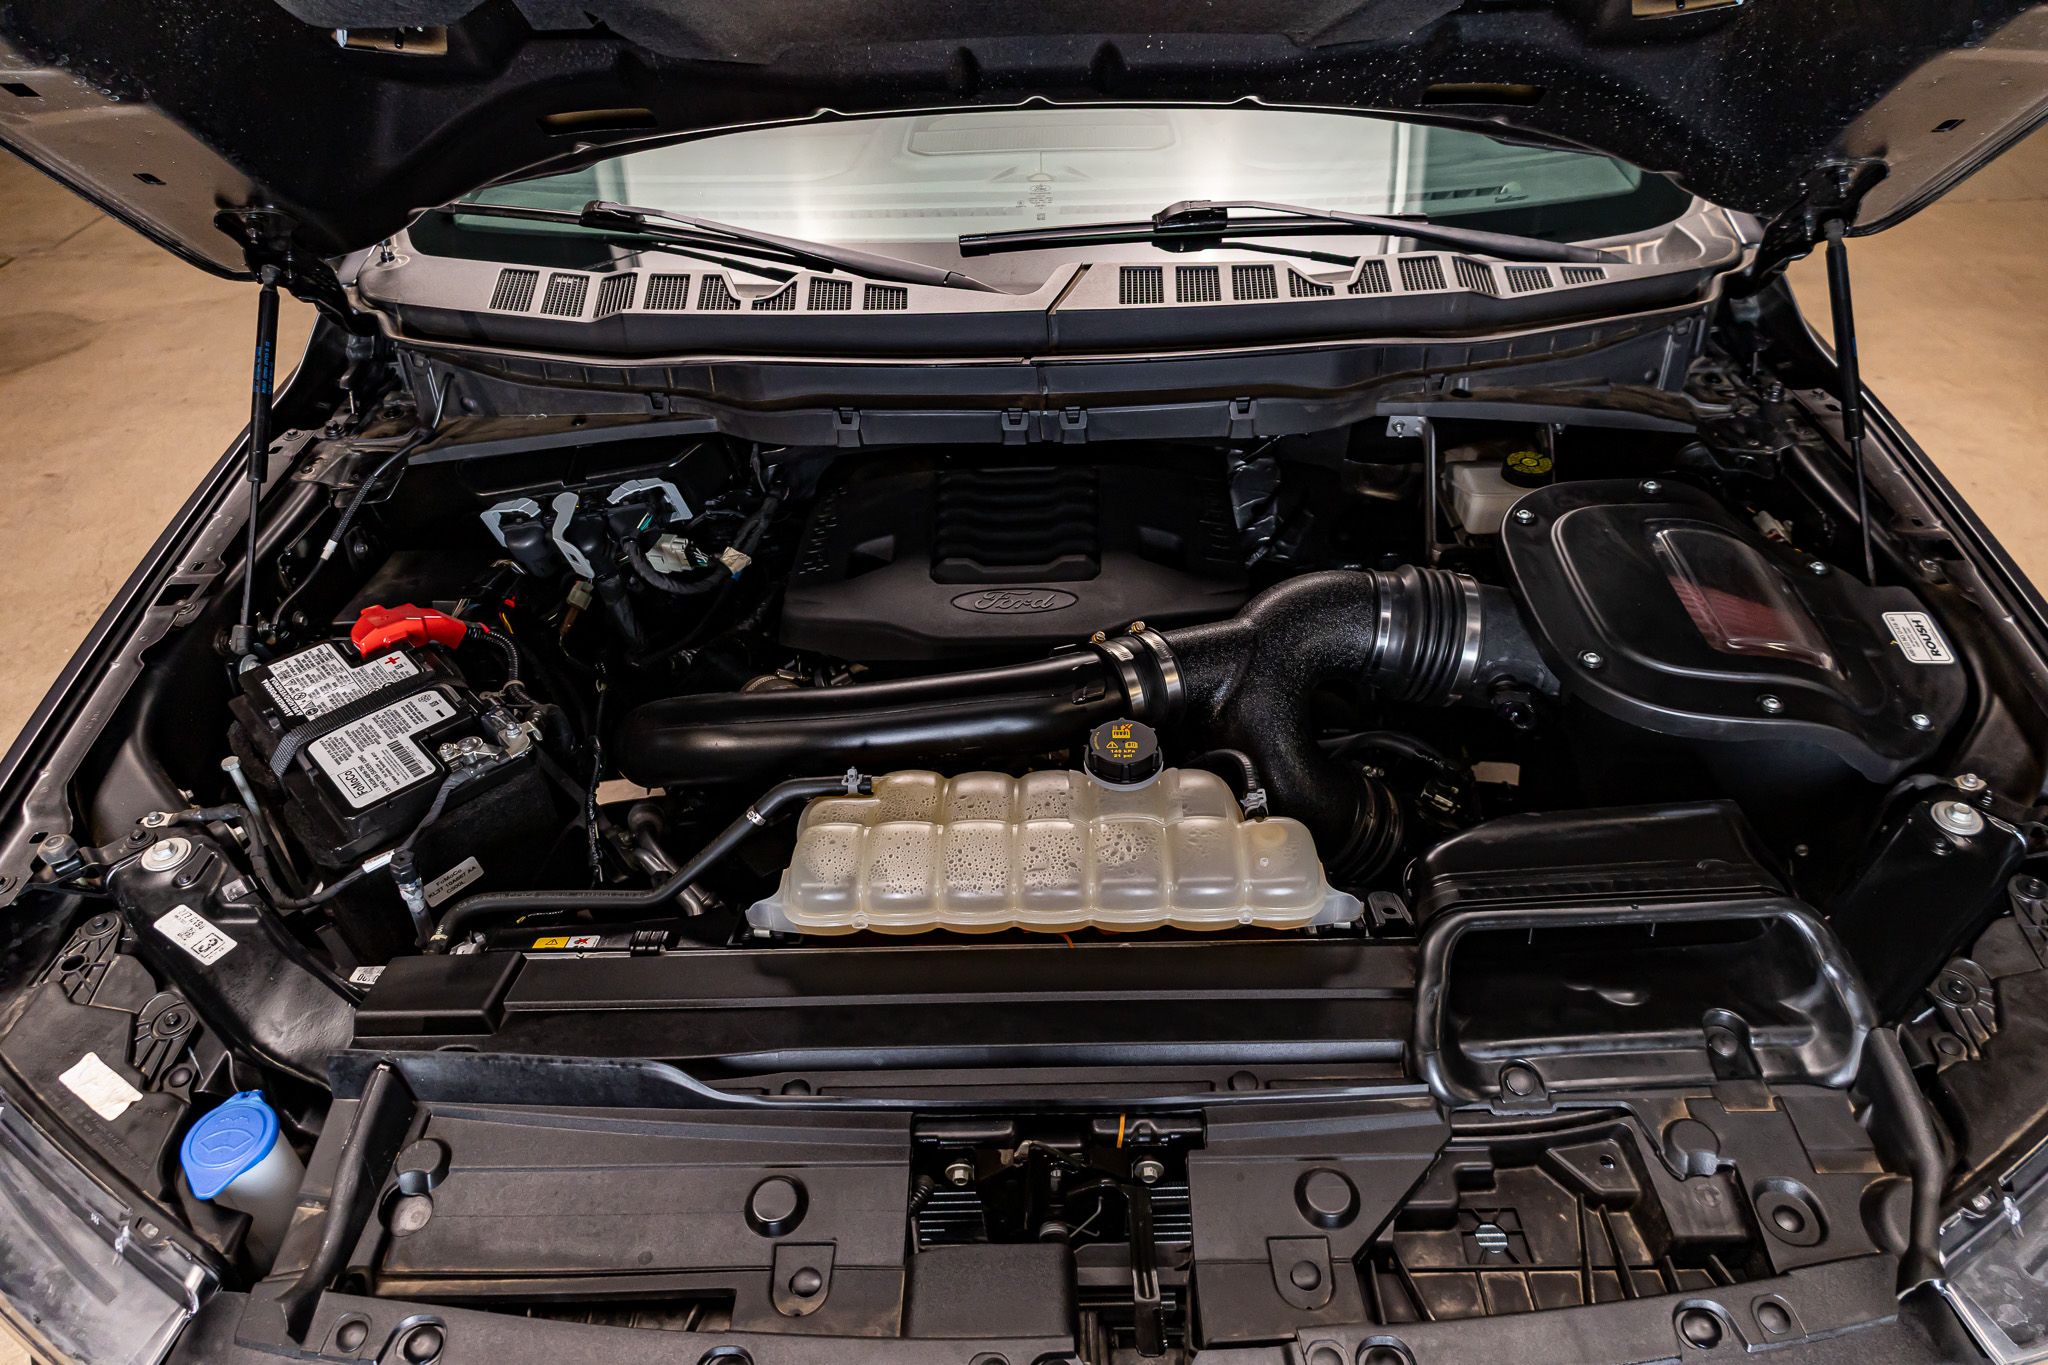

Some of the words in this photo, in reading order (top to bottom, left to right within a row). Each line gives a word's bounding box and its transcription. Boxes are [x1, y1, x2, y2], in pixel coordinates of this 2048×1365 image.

[974, 590, 1056, 610] Ford
[1912, 620, 1942, 656] ROUSH
[344, 769, 369, 796] FoMoCo
[435, 867, 462, 886] FoMoCo
[196, 936, 220, 954] 3
